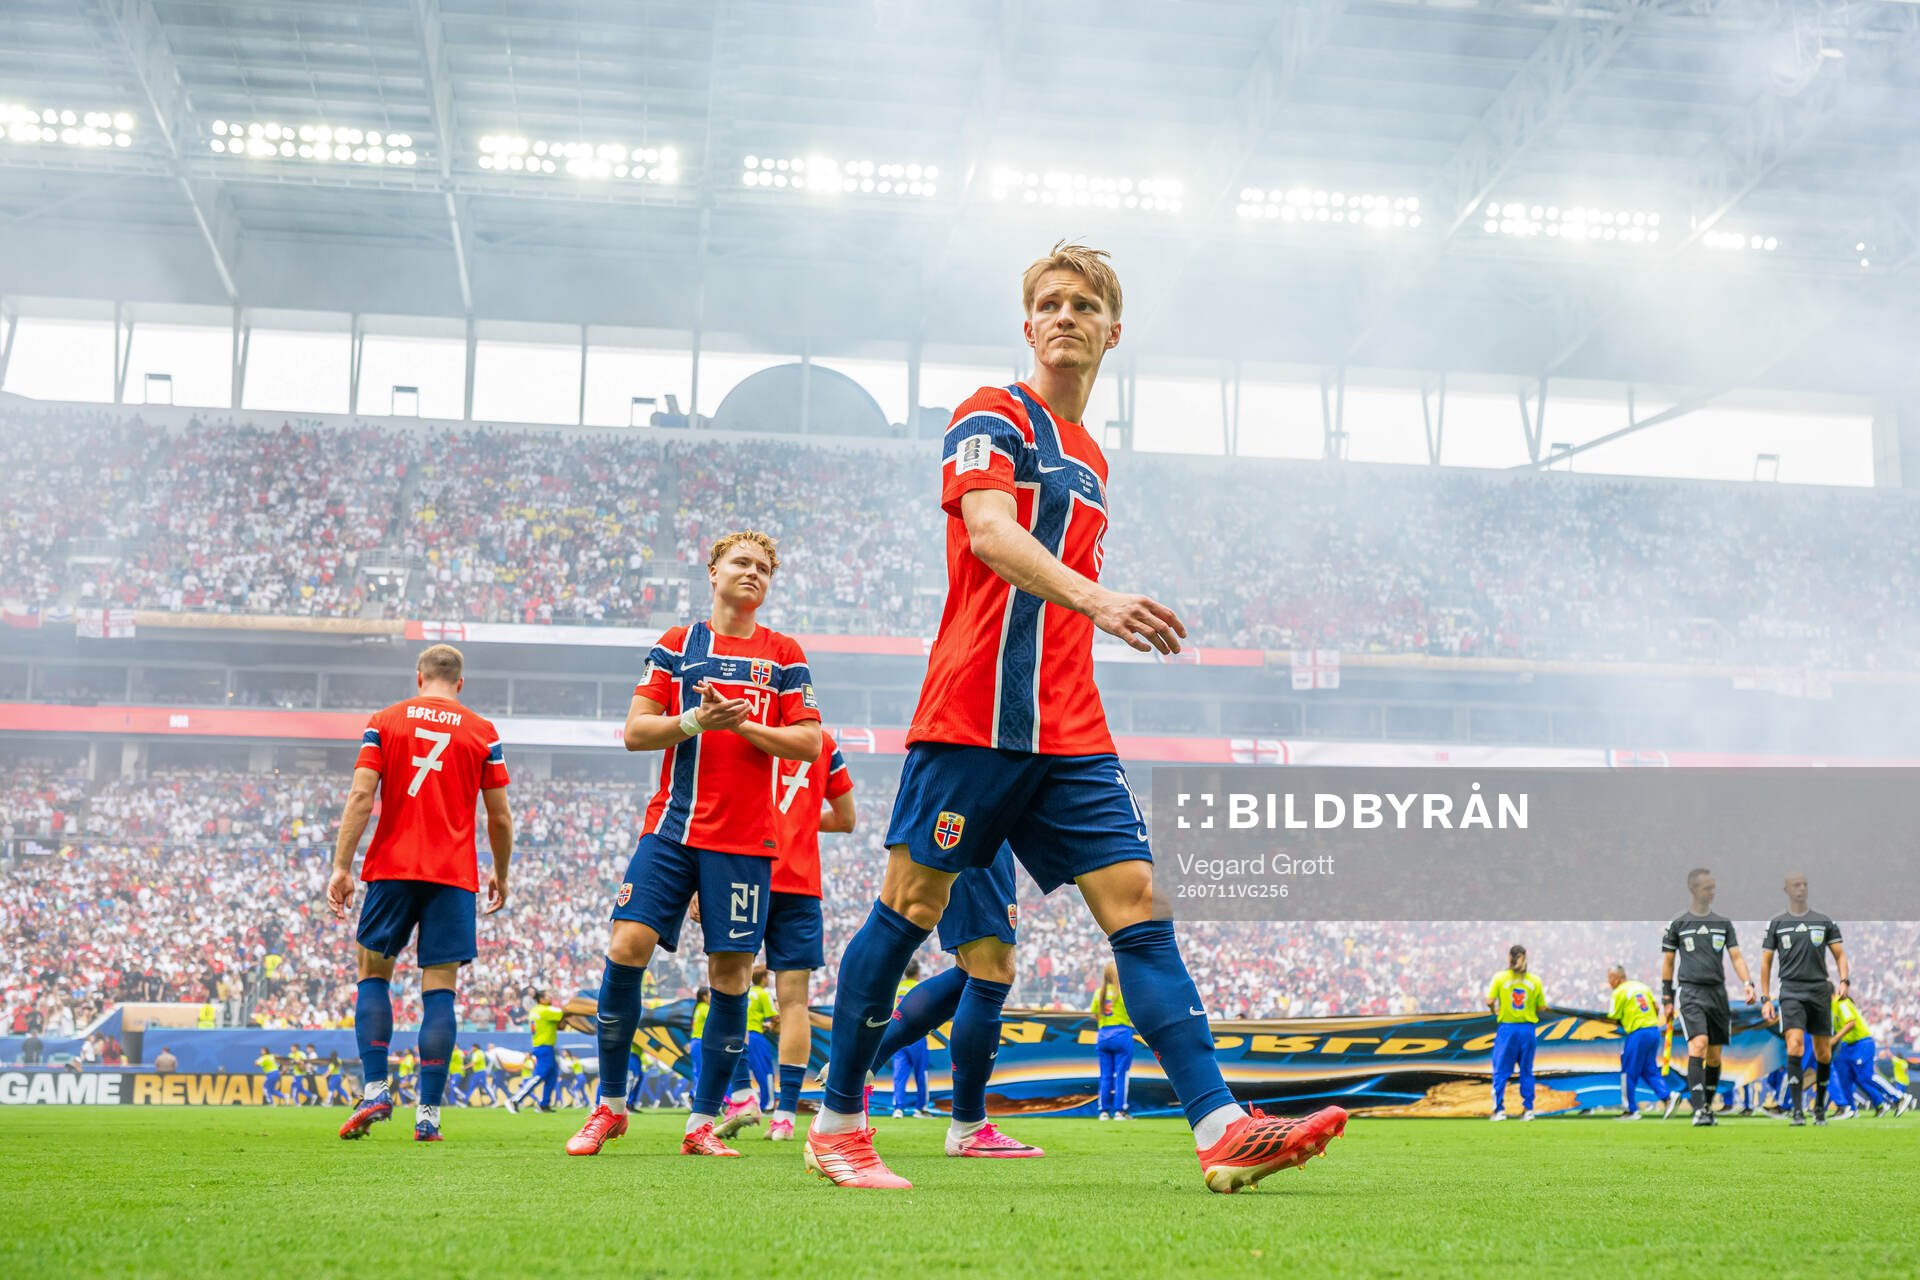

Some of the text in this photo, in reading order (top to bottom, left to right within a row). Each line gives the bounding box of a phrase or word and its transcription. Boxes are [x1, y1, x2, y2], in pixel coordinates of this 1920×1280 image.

[406, 705, 462, 727] SØRLOTH
[407, 727, 452, 798] 7
[730, 882, 760, 924] 21
[0, 1072, 122, 1105] GAME
